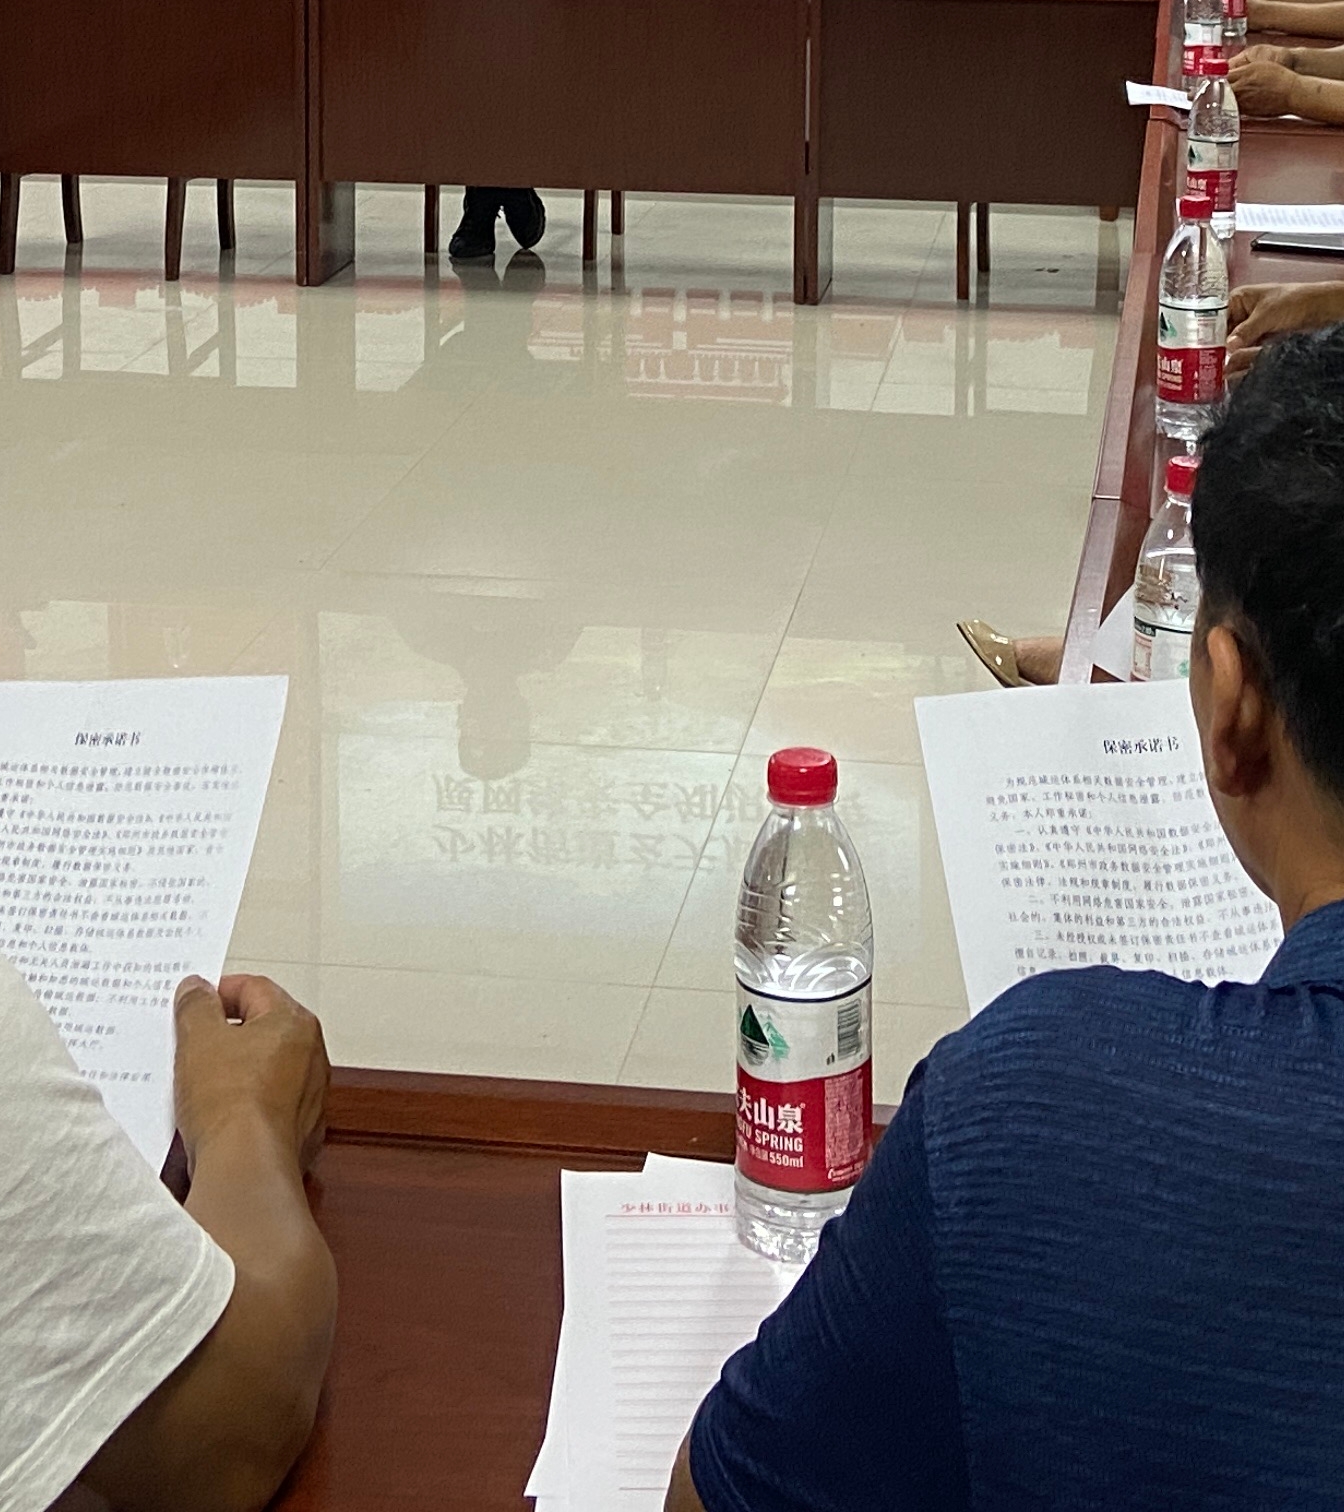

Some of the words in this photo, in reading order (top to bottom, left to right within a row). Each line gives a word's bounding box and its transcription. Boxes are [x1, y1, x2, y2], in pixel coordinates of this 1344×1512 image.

[1103, 736, 1179, 755] 保密承诺书
[738, 1086, 804, 1134] 夫山泉
[754, 1128, 804, 1153] SPRING
